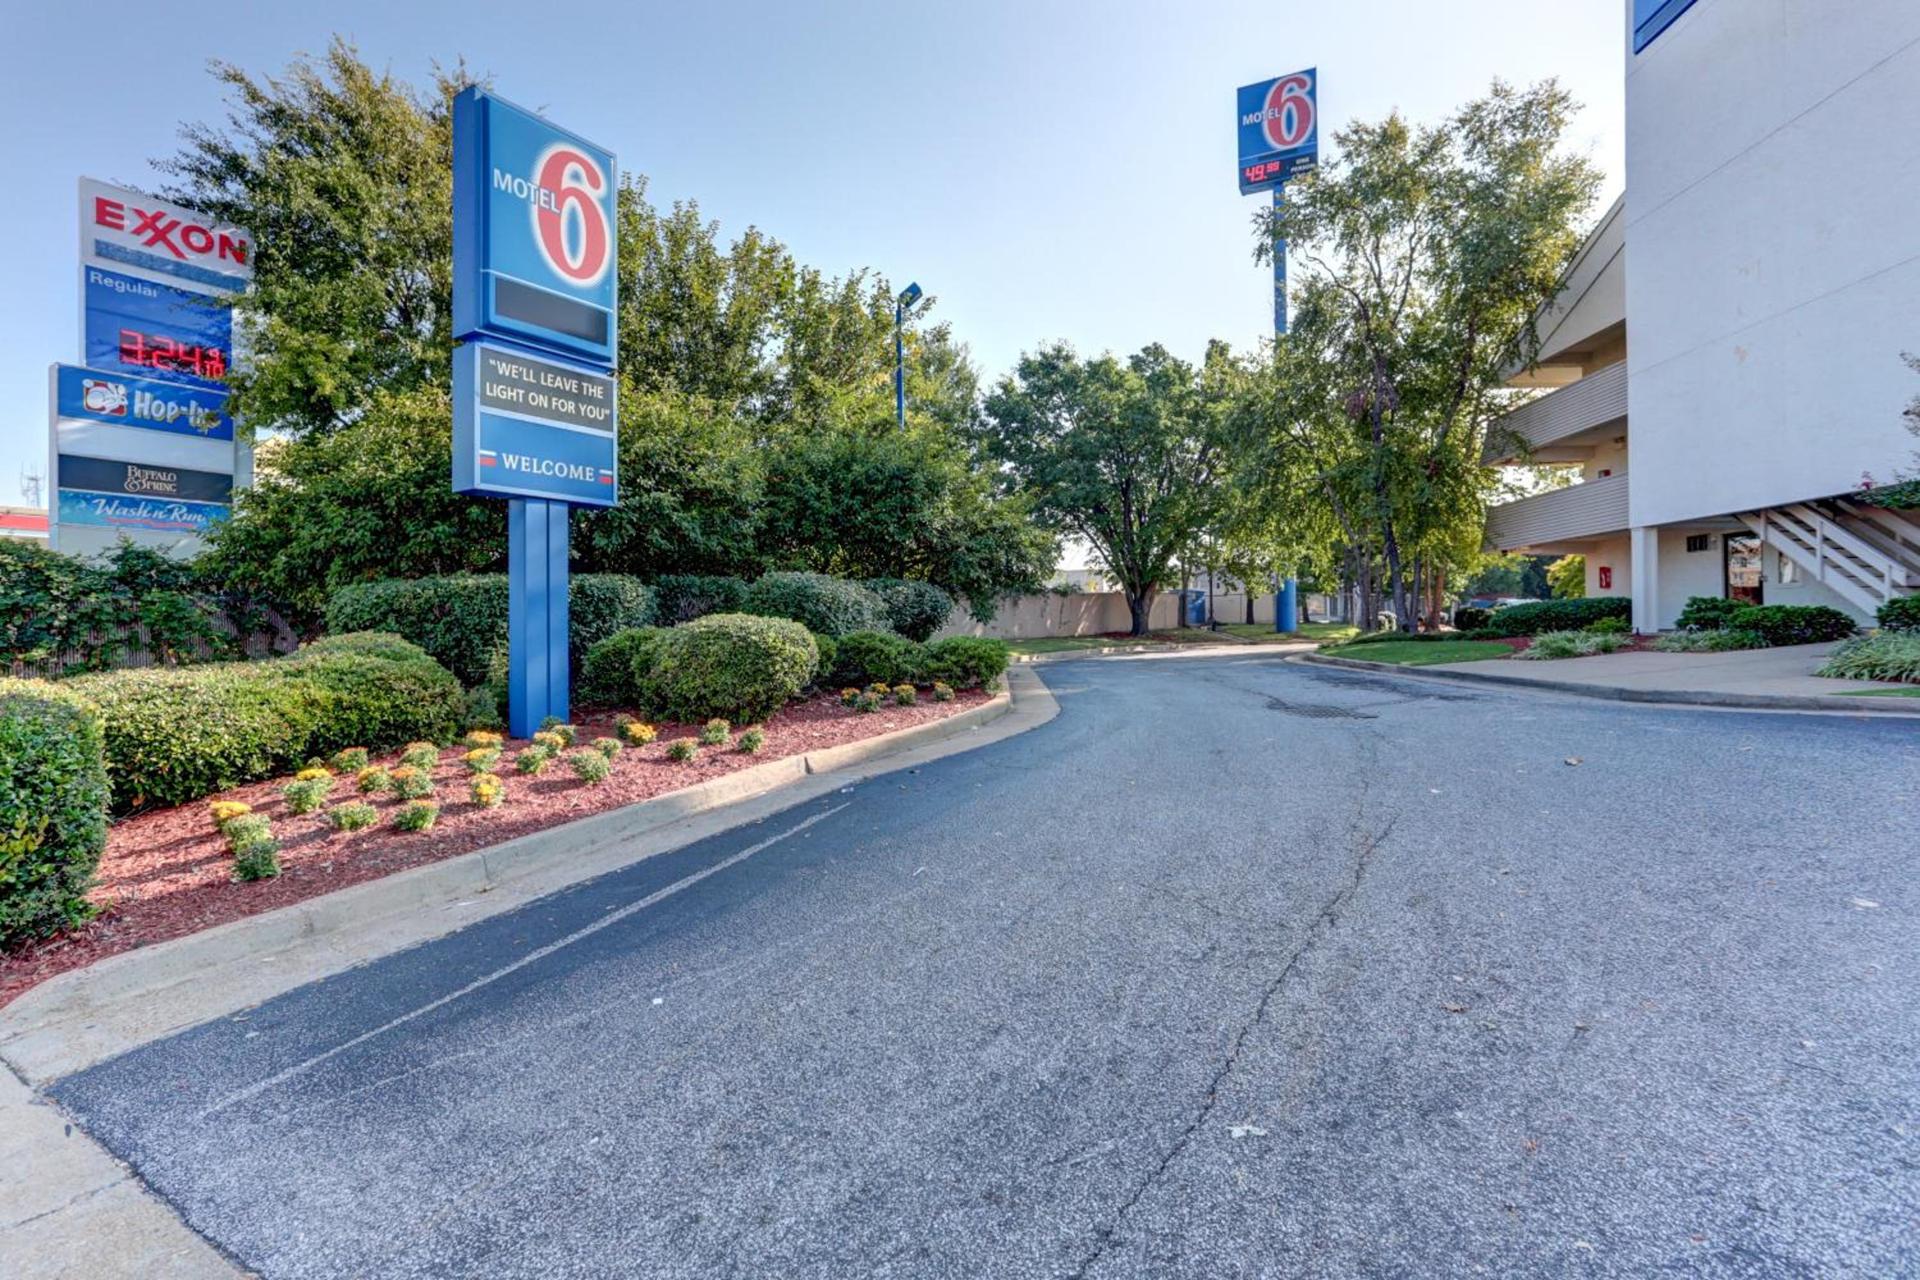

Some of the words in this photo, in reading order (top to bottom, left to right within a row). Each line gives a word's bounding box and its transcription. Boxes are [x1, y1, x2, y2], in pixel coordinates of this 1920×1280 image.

[1242, 107, 1281, 126] MOTEL
[1264, 74, 1313, 150] 6
[95, 196, 247, 265] EXXON
[493, 168, 560, 213] MOTEL
[532, 144, 609, 286] 6
[486, 382, 525, 402] LIGHT
[528, 392, 548, 408] ON
[552, 397, 576, 414] FOR
[540, 371, 578, 393] LEAVE
[582, 381, 604, 399] THE
[127, 465, 177, 483] BUFFALO
[502, 452, 595, 483] WELCOME
[92, 498, 151, 518] Wash
